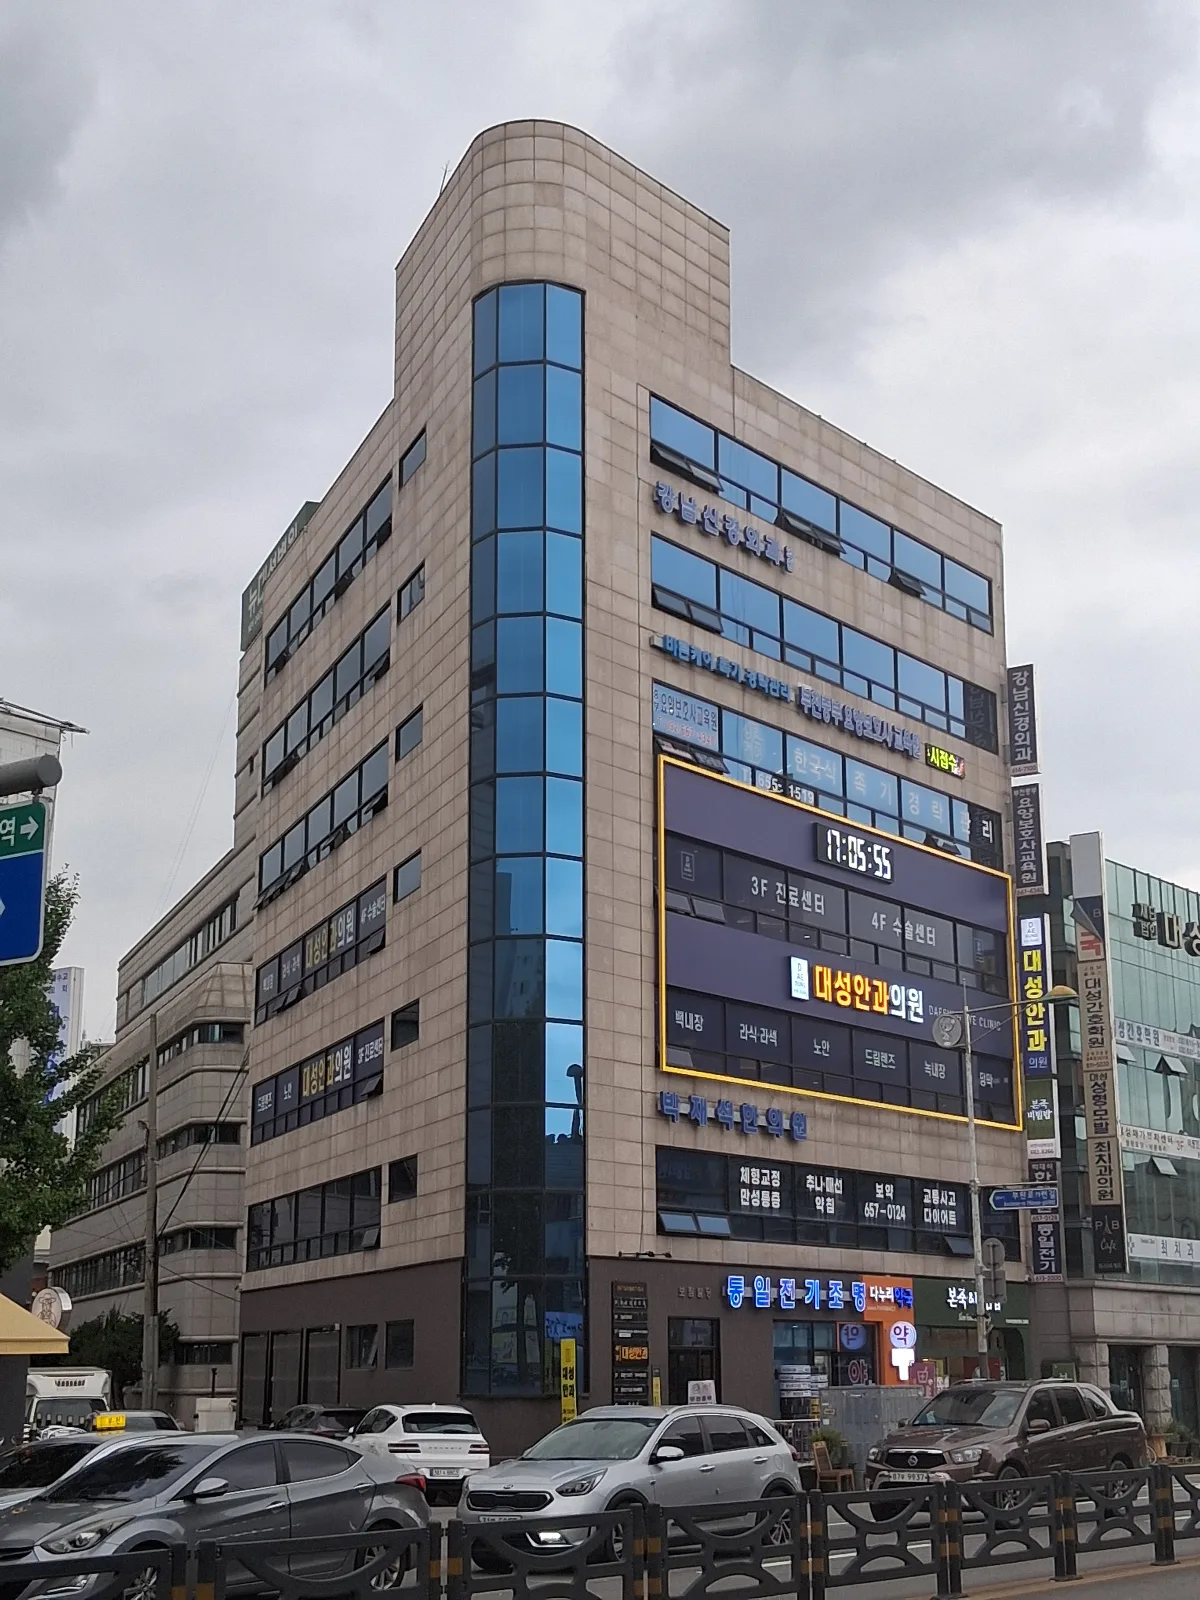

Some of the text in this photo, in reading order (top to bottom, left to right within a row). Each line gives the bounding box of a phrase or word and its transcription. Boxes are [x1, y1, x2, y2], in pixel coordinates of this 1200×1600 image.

[653, 481, 779, 565] 강남신경외과
[1012, 670, 1032, 761] 강남신경외과
[793, 748, 837, 785] 한국식
[827, 828, 892, 880] 17:05:55
[1017, 797, 1037, 884] 요양보호사교육원
[751, 876, 825, 915] 3F 진료센터
[305, 907, 354, 969] 대성안과의원
[871, 912, 936, 947] 4F 수술센터
[814, 964, 923, 1024] 대성안과의원
[1023, 949, 1047, 1052] 대성안과
[675, 1010, 704, 1032] 백내장
[1085, 977, 1105, 1049] 대성간호학원
[813, 1038, 830, 1056] 노안
[865, 1049, 896, 1069] 드림렌즈
[1028, 1056, 1048, 1069] 의원
[302, 1044, 352, 1097] 대성안과의원
[924, 1061, 946, 1079] 녹내장
[659, 1091, 807, 1141] 박재석한의원
[1030, 1098, 1049, 1109] 본죽
[740, 1166, 780, 1187] 체형교정
[1094, 1141, 1113, 1201] 최치과의원
[740, 1188, 780, 1209] 만성통증
[815, 1196, 835, 1214] 약침
[875, 1183, 894, 1201] 보약
[923, 1188, 956, 1206] 교통사고
[864, 1202, 906, 1221] 657-0124
[923, 1208, 957, 1226] 다이어트
[1038, 1223, 1056, 1273] 통일전기
[727, 1275, 866, 1313] 통일전기조명
[893, 1325, 909, 1345] 약
